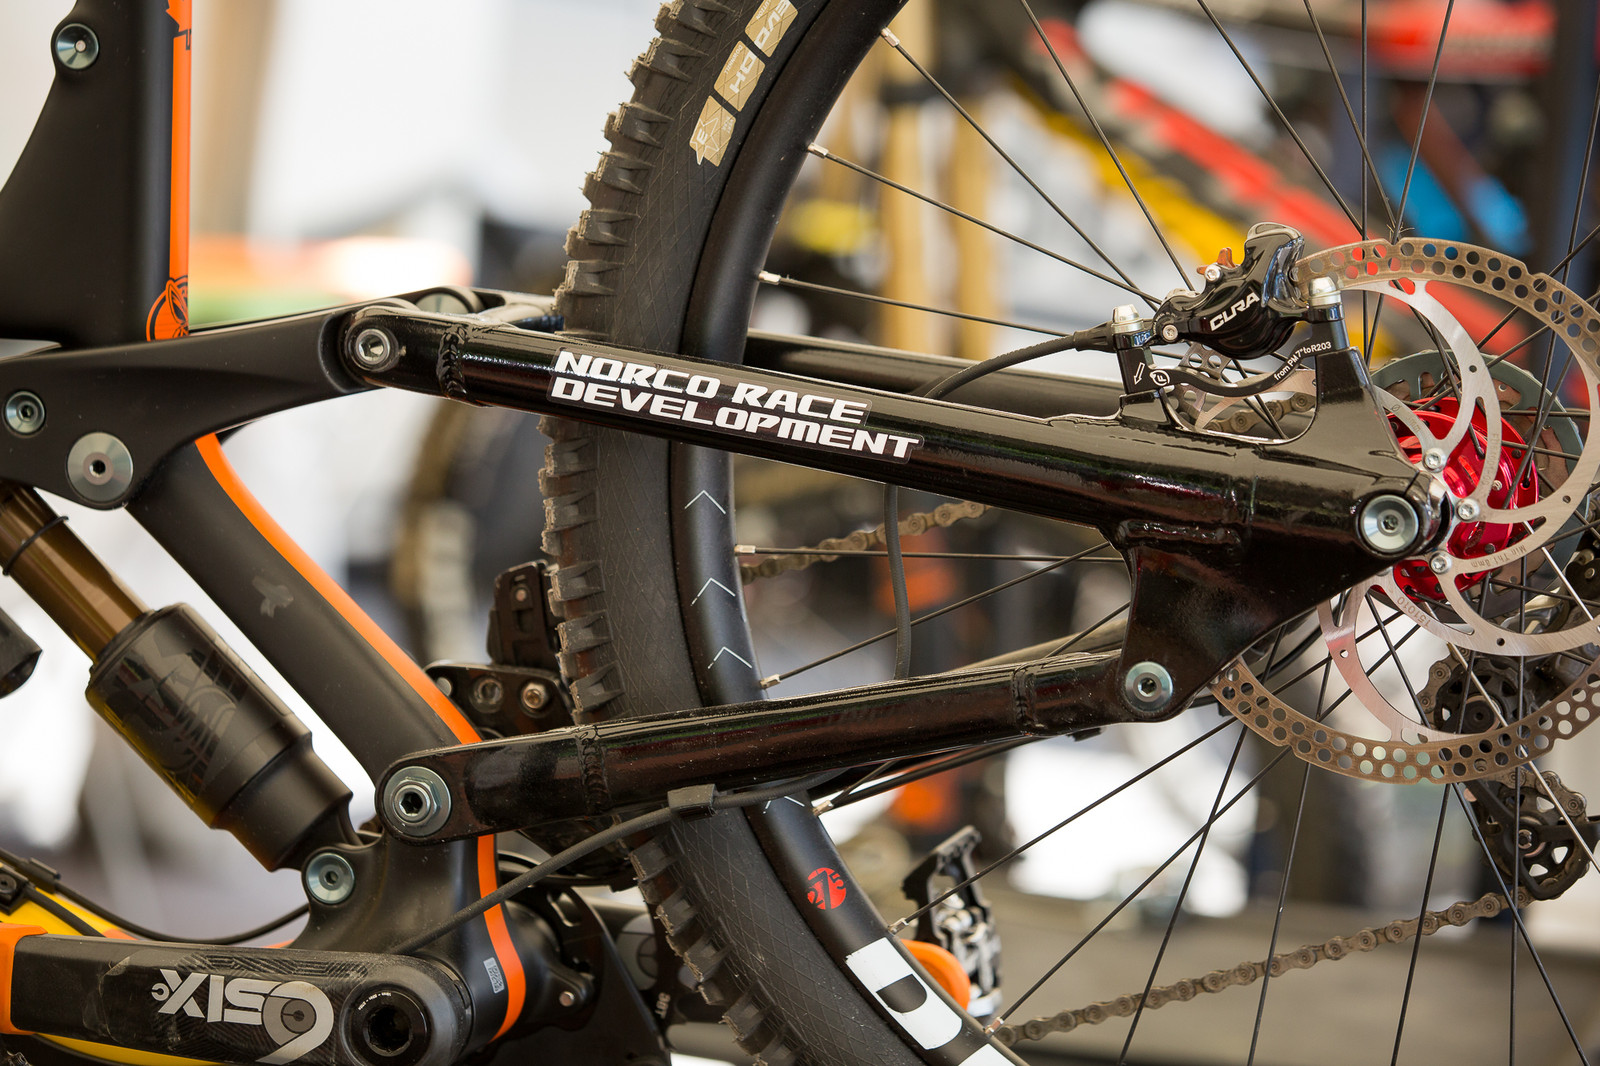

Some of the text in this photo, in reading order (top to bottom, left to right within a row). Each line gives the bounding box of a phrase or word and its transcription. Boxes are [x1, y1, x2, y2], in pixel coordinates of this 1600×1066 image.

[1209, 291, 1261, 332] CURA
[1273, 365, 1290, 380] from
[1287, 354, 1299, 367] PM
[1310, 341, 1332, 352] R203
[554, 350, 869, 425] NORCO RACE
[550, 376, 921, 459] DEVELOPMENT
[1396, 596, 1431, 628] 151010
